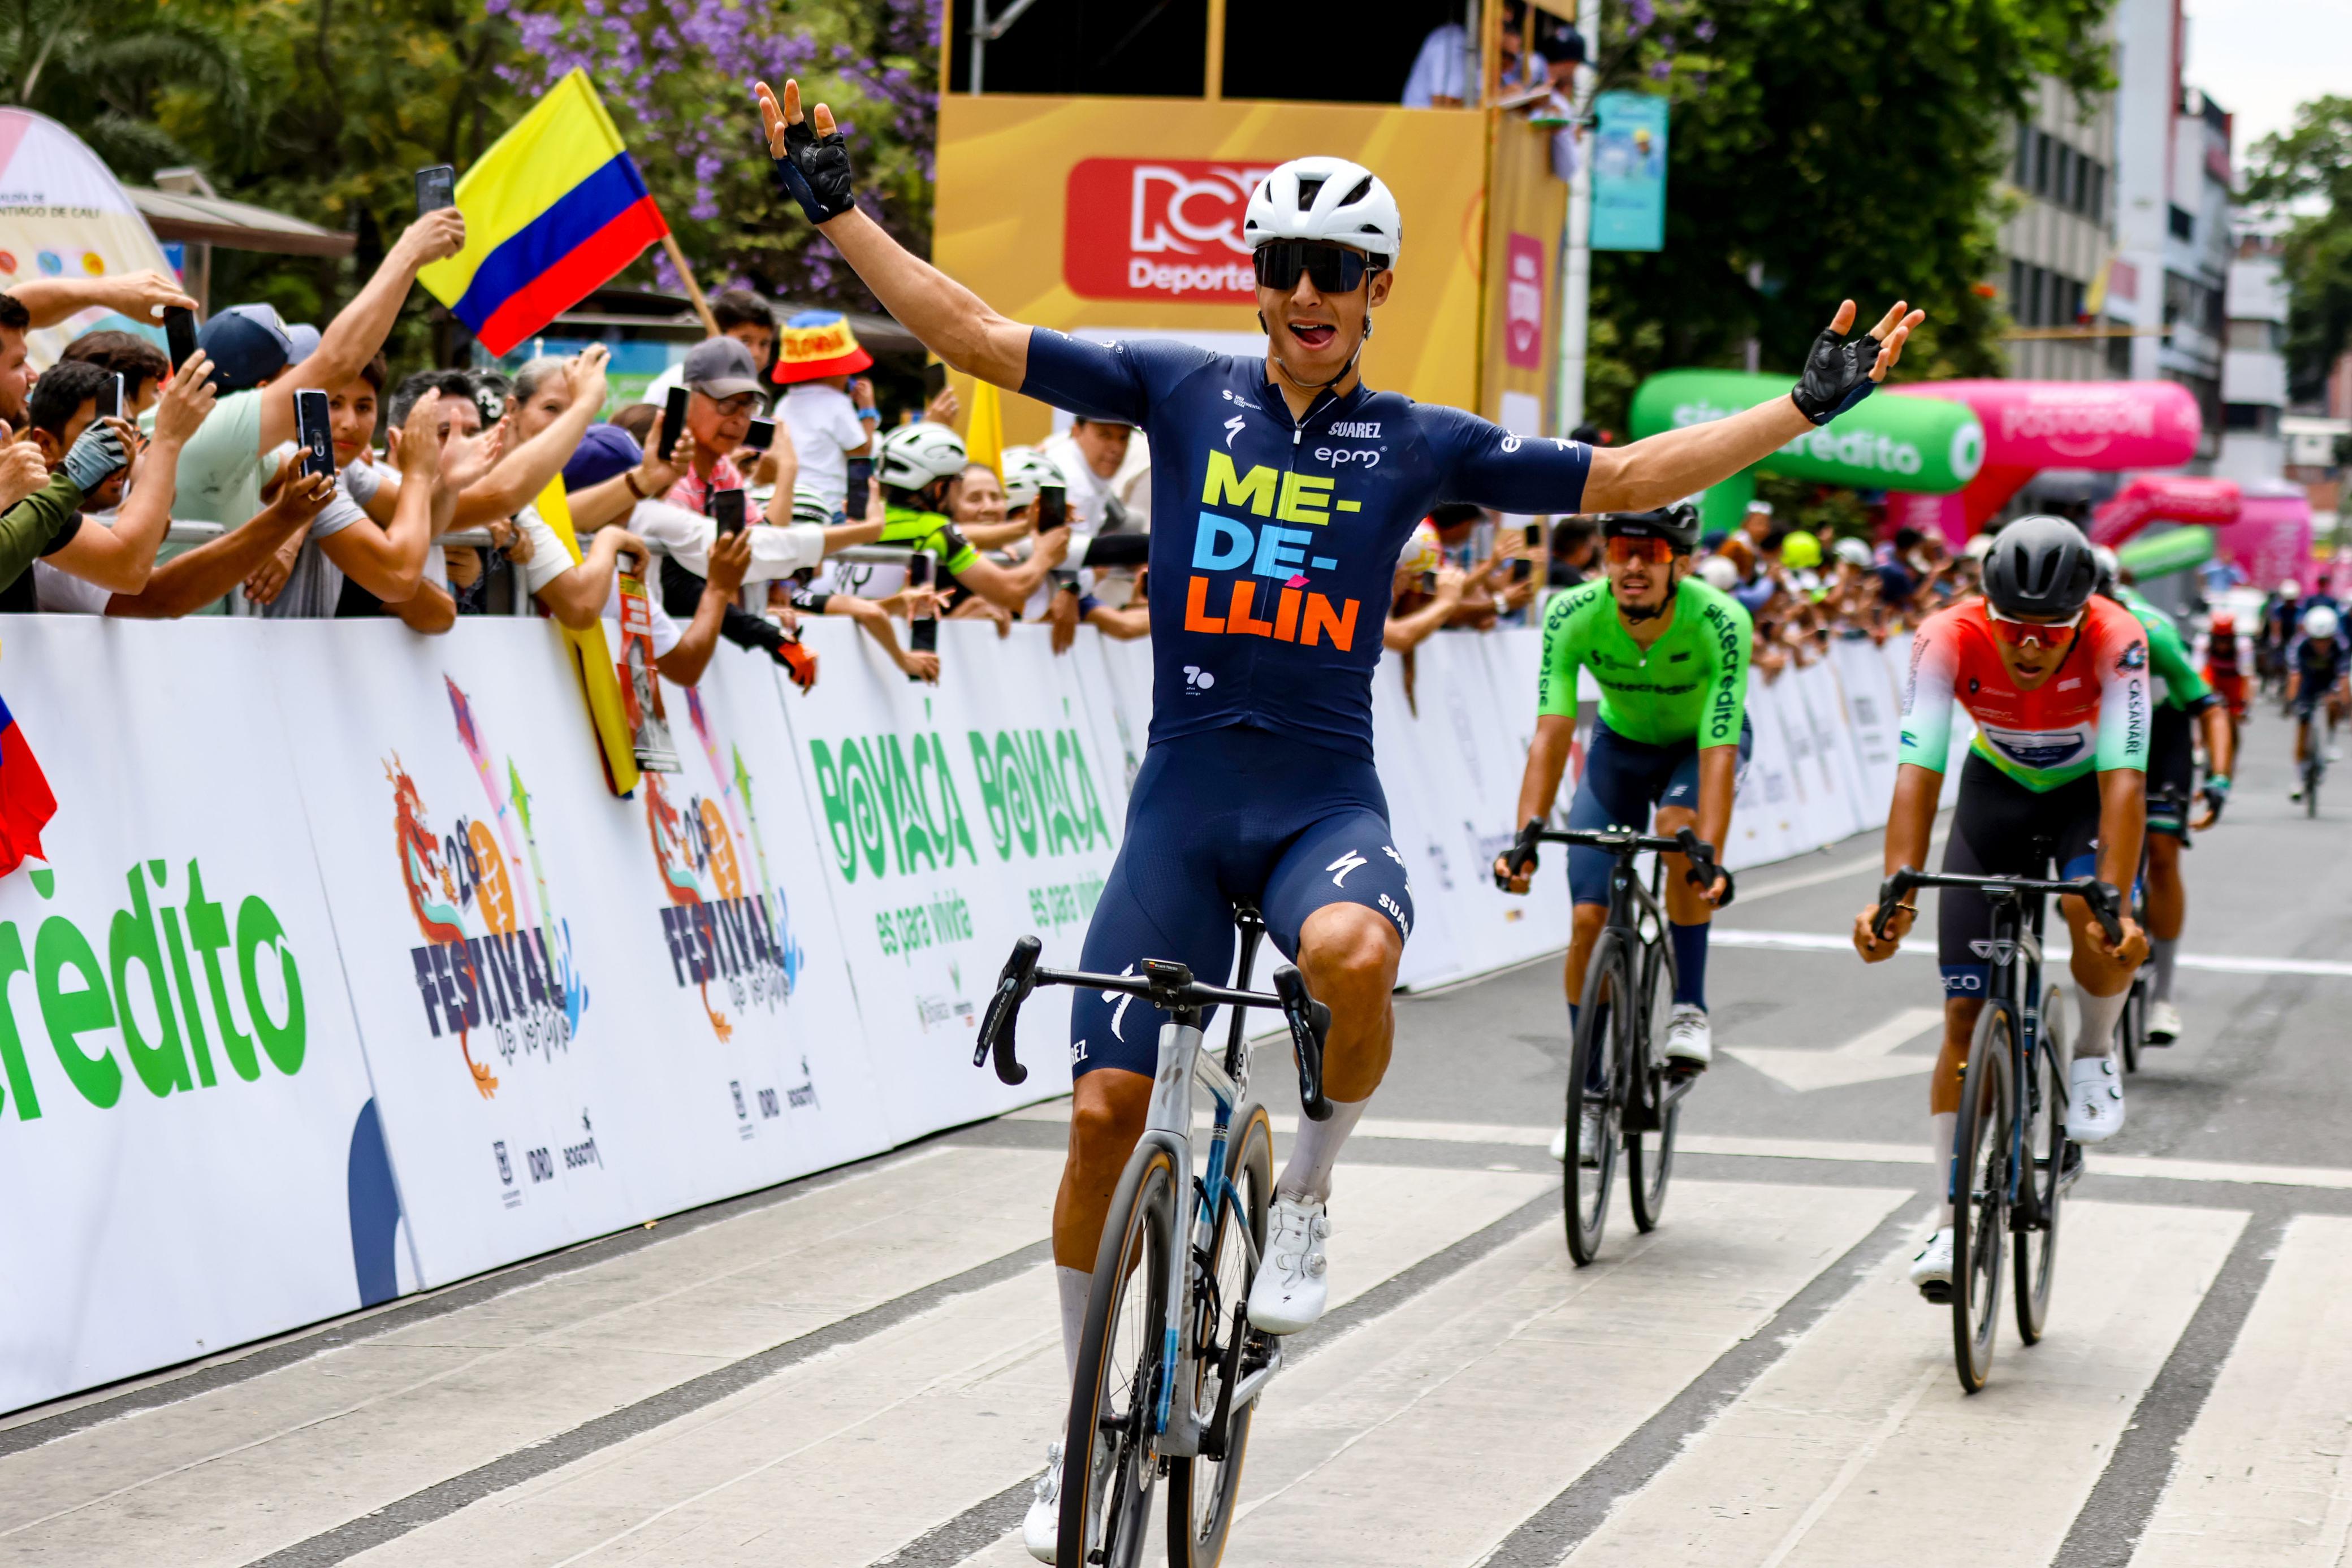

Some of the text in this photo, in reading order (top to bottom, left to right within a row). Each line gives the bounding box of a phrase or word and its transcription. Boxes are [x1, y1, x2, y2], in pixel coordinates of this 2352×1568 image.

[1129, 258, 1256, 294] Deporte
[1328, 421, 1382, 439] SUAREZ
[1202, 449, 1362, 526] ME-
[1192, 511, 1338, 582] DE-
[1184, 573, 1361, 652] LLÍN
[2125, 679, 2142, 756] CASANARE
[809, 698, 1113, 884] BOYACÁ BOYACÁ
[659, 894, 787, 987] FESTIVAL
[1378, 893, 1409, 943] SUAR
[0, 856, 306, 1123] rédito
[410, 927, 568, 1038] FESTIVAL
